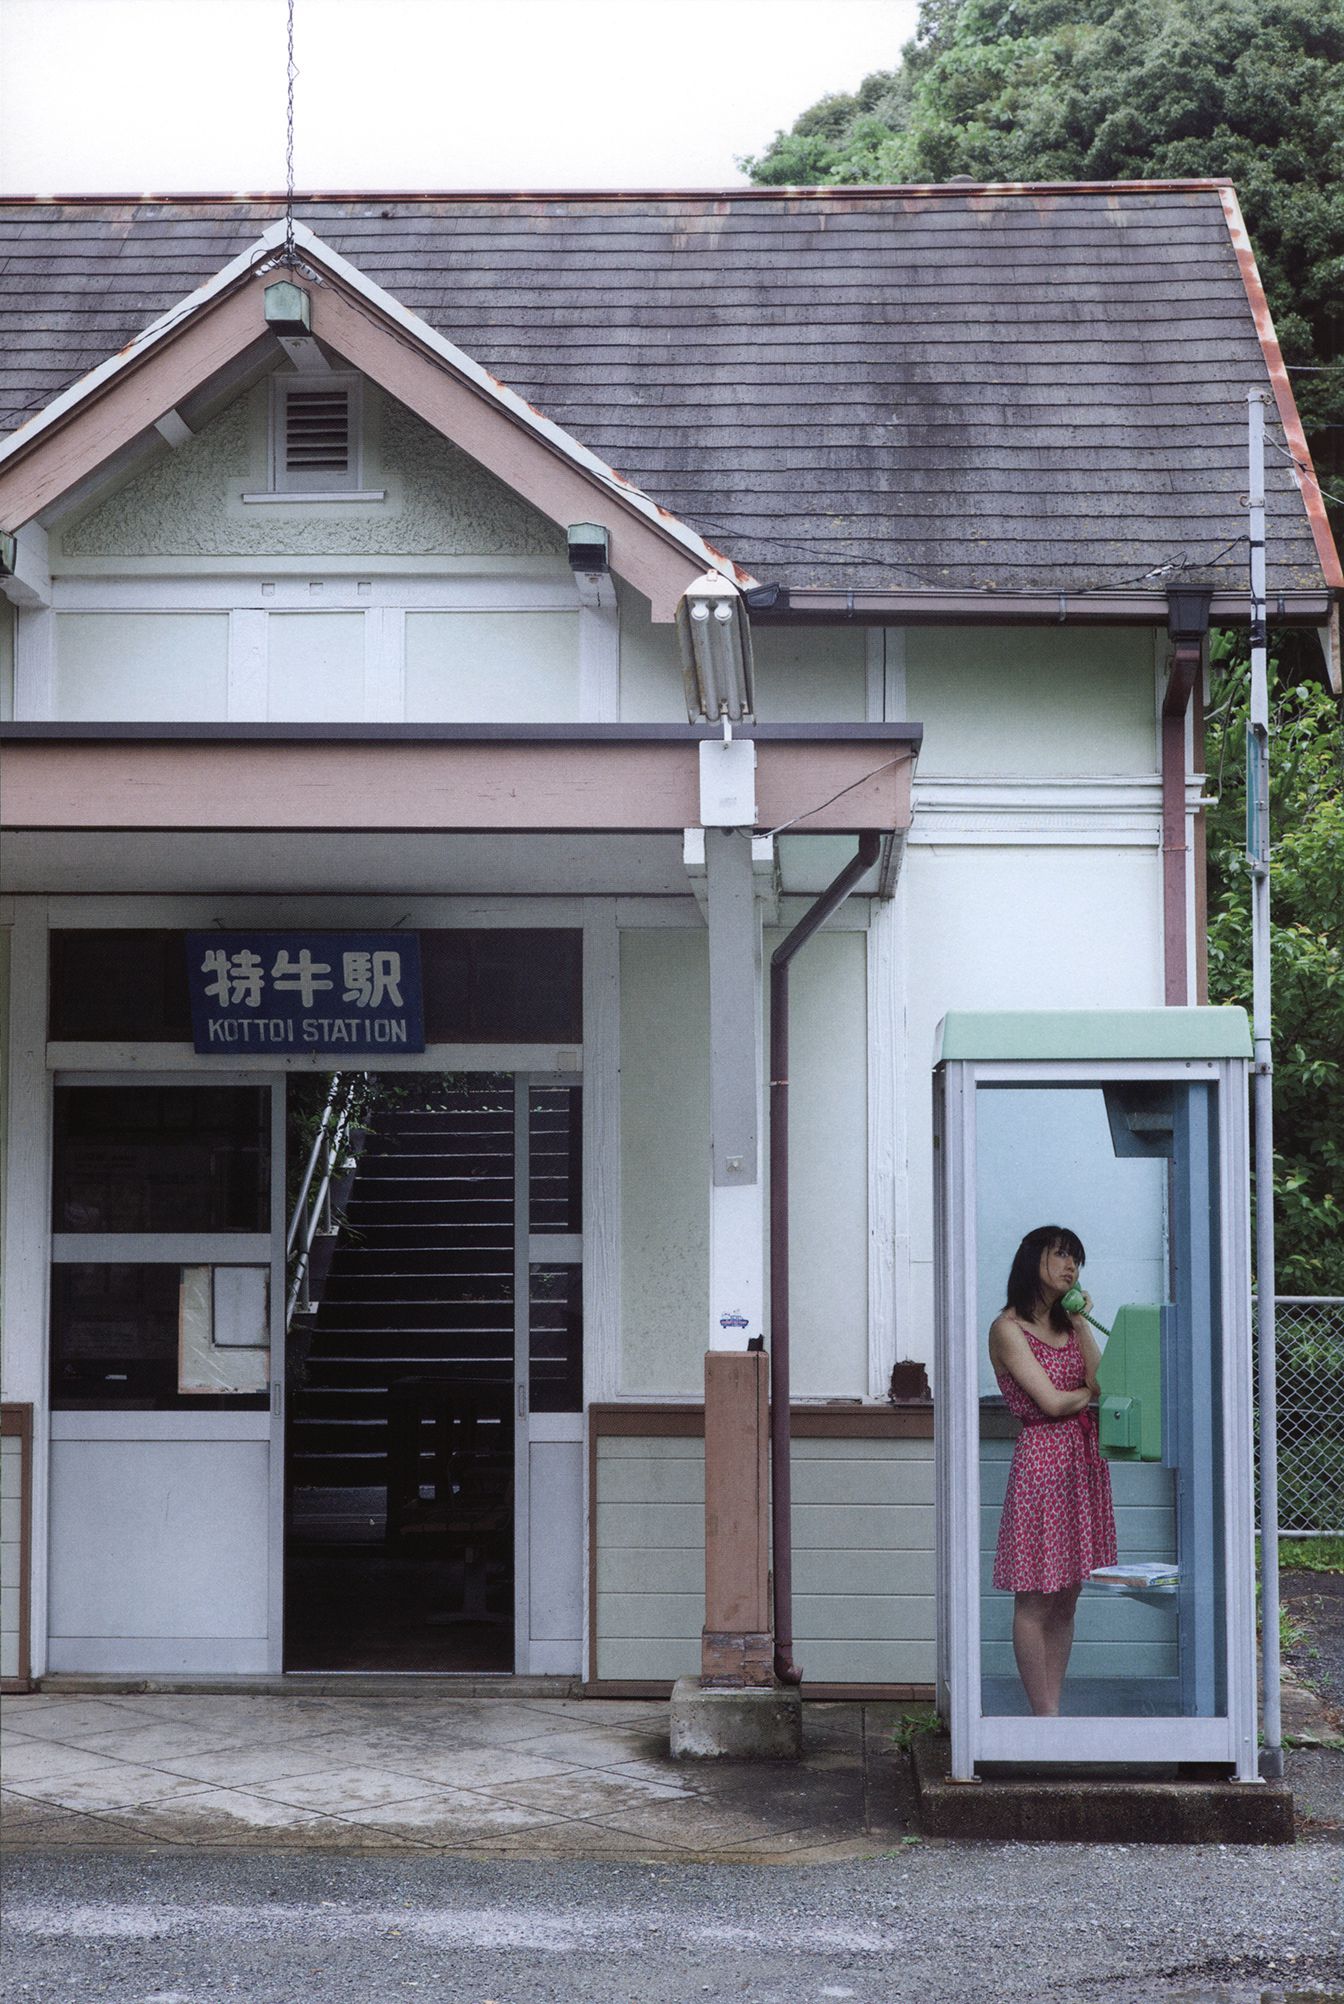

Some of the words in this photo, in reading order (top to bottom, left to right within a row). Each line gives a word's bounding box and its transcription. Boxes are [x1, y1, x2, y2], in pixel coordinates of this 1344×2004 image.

[201, 949, 404, 1007] 特牛駅
[208, 1018, 294, 1042] KOTTOI
[303, 1018, 407, 1042] STATION
